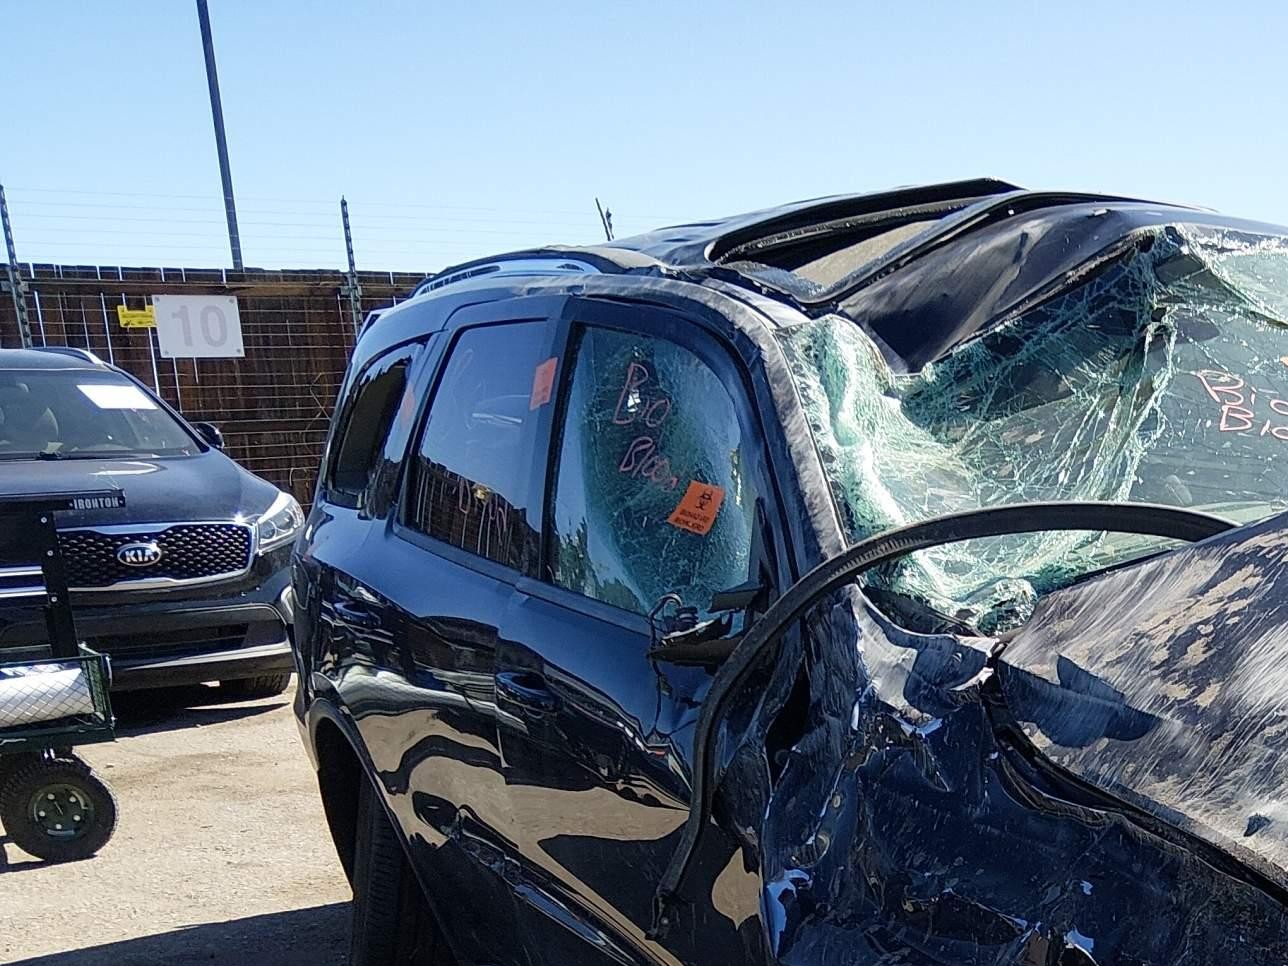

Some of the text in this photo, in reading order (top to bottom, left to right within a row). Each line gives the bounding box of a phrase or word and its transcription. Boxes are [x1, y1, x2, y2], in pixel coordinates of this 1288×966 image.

[171, 304, 228, 348] 10
[73, 497, 119, 510] IRONTON
[125, 549, 156, 563] KIA
